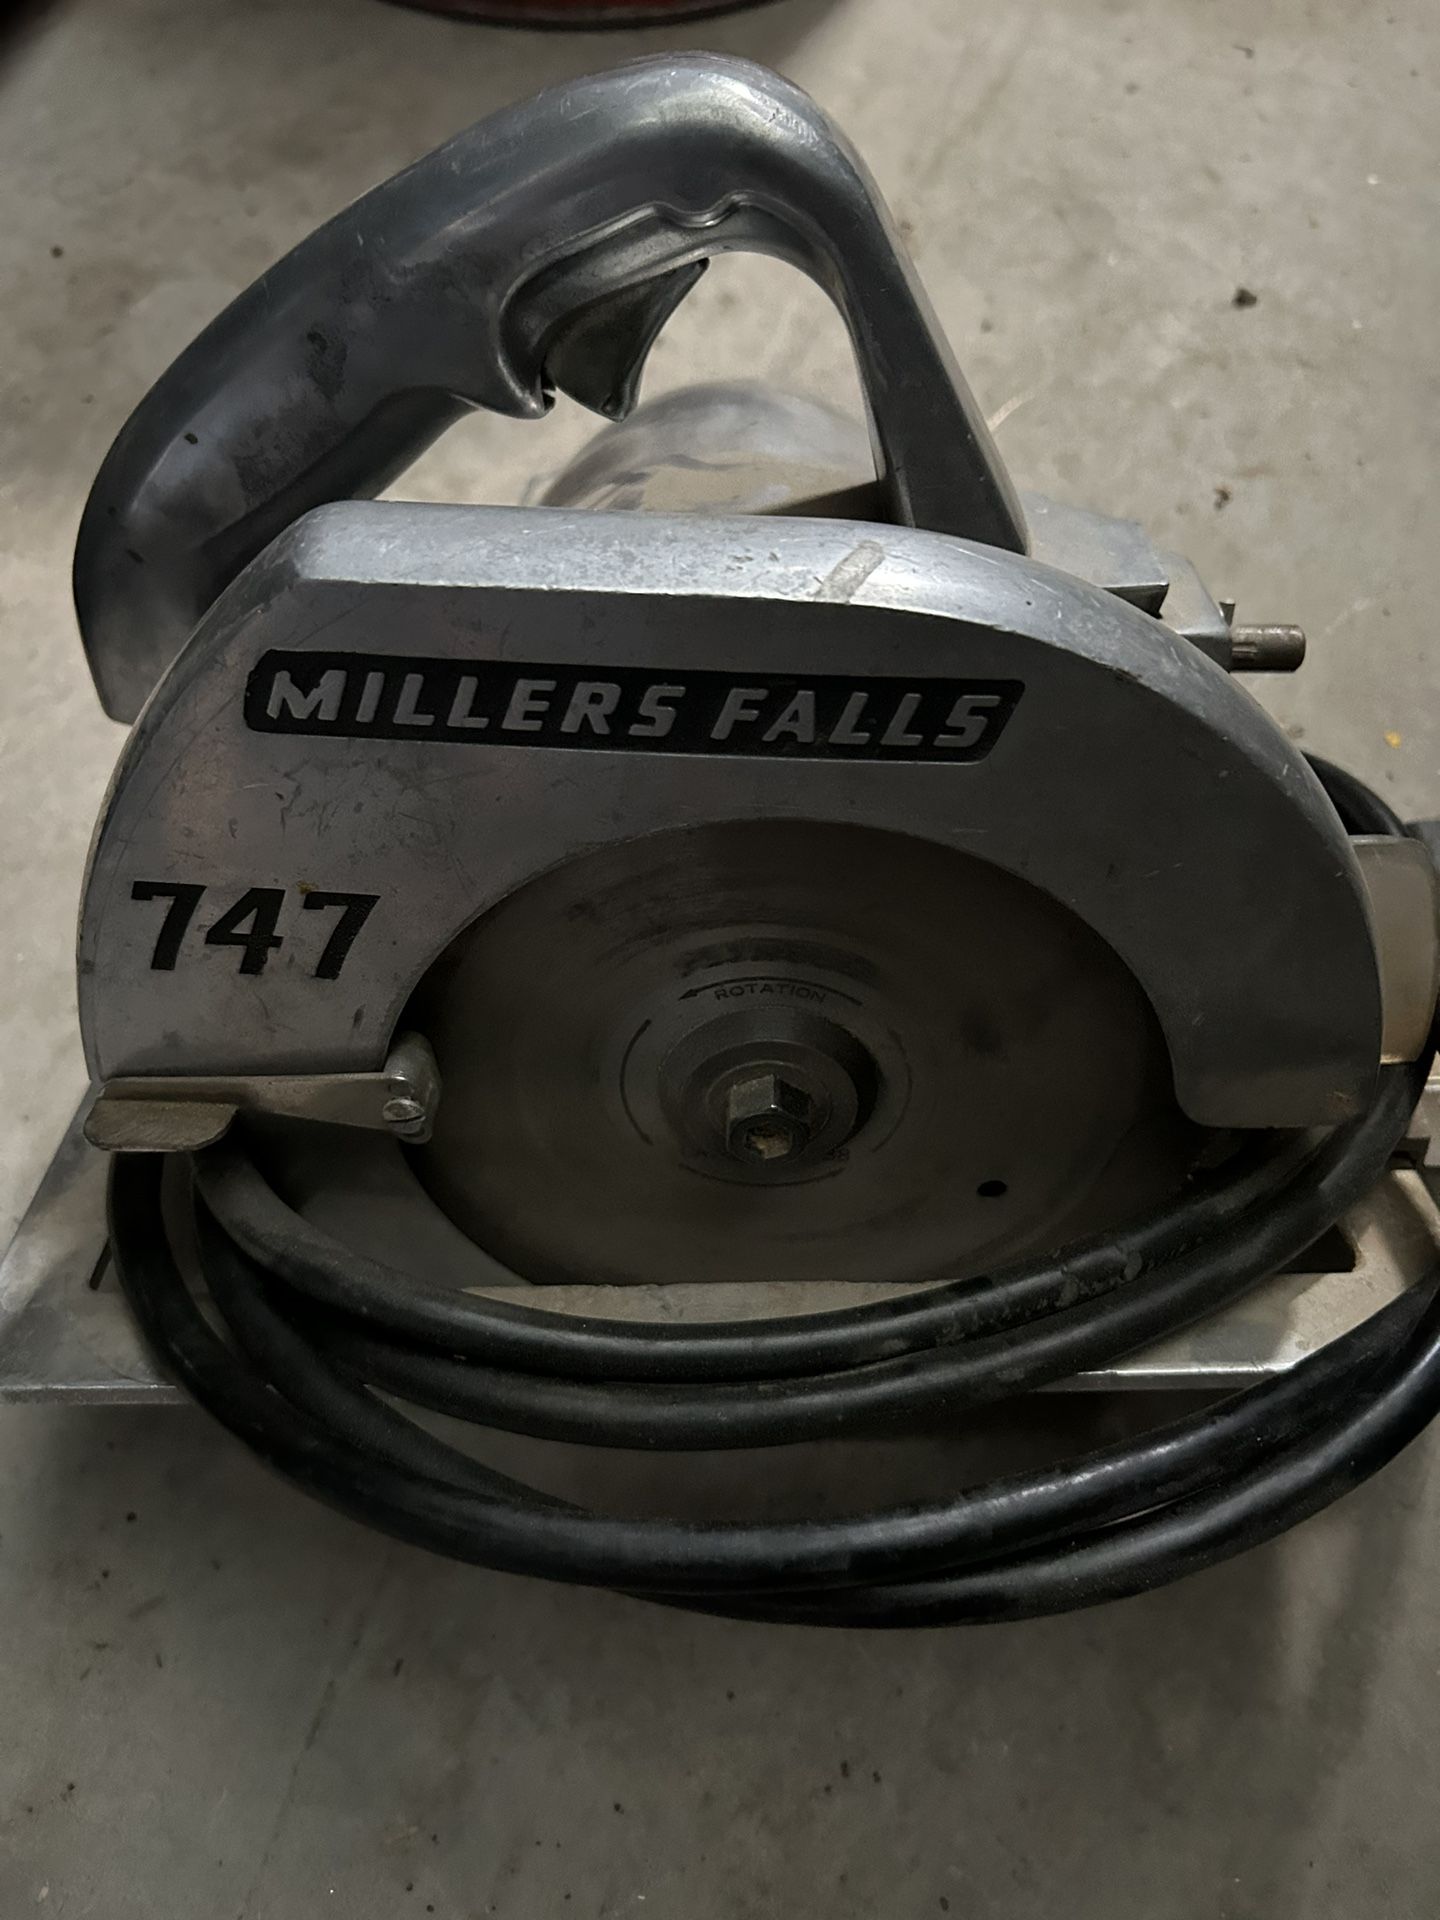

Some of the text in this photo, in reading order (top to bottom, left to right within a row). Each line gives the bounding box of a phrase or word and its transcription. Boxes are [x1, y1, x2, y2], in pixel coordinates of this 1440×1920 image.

[266, 670, 1002, 748] MILLERS FALLS
[131, 881, 381, 980] 747
[715, 983, 826, 1003] ROTATION
